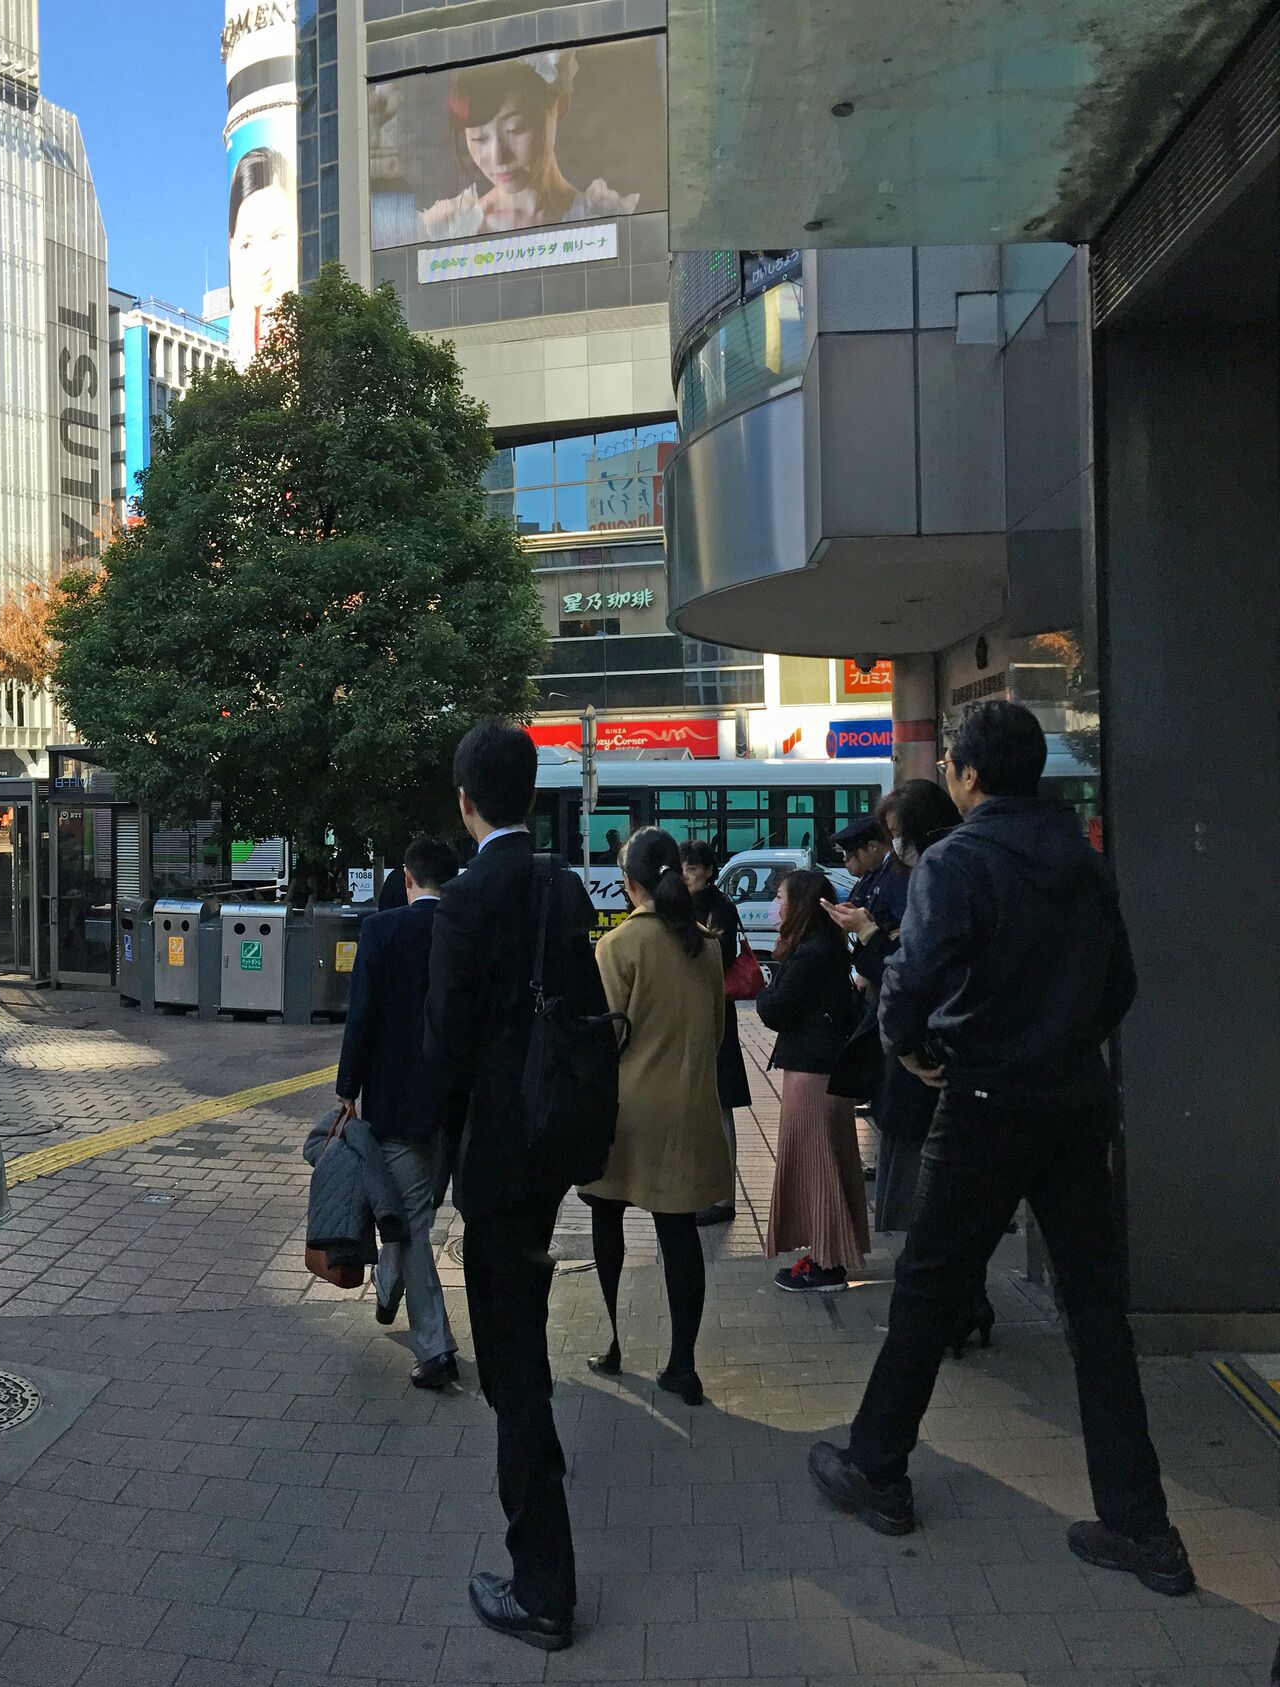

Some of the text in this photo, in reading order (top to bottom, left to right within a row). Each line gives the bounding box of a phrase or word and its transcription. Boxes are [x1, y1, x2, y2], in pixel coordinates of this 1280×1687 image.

[495, 242, 558, 262] フリルサラダ
[58, 301, 100, 562] TSUTA
[563, 588, 654, 613] 星乃珈琲
[850, 671, 892, 685] プロミス
[613, 735, 648, 745] Corner
[349, 871, 373, 879] T1088
